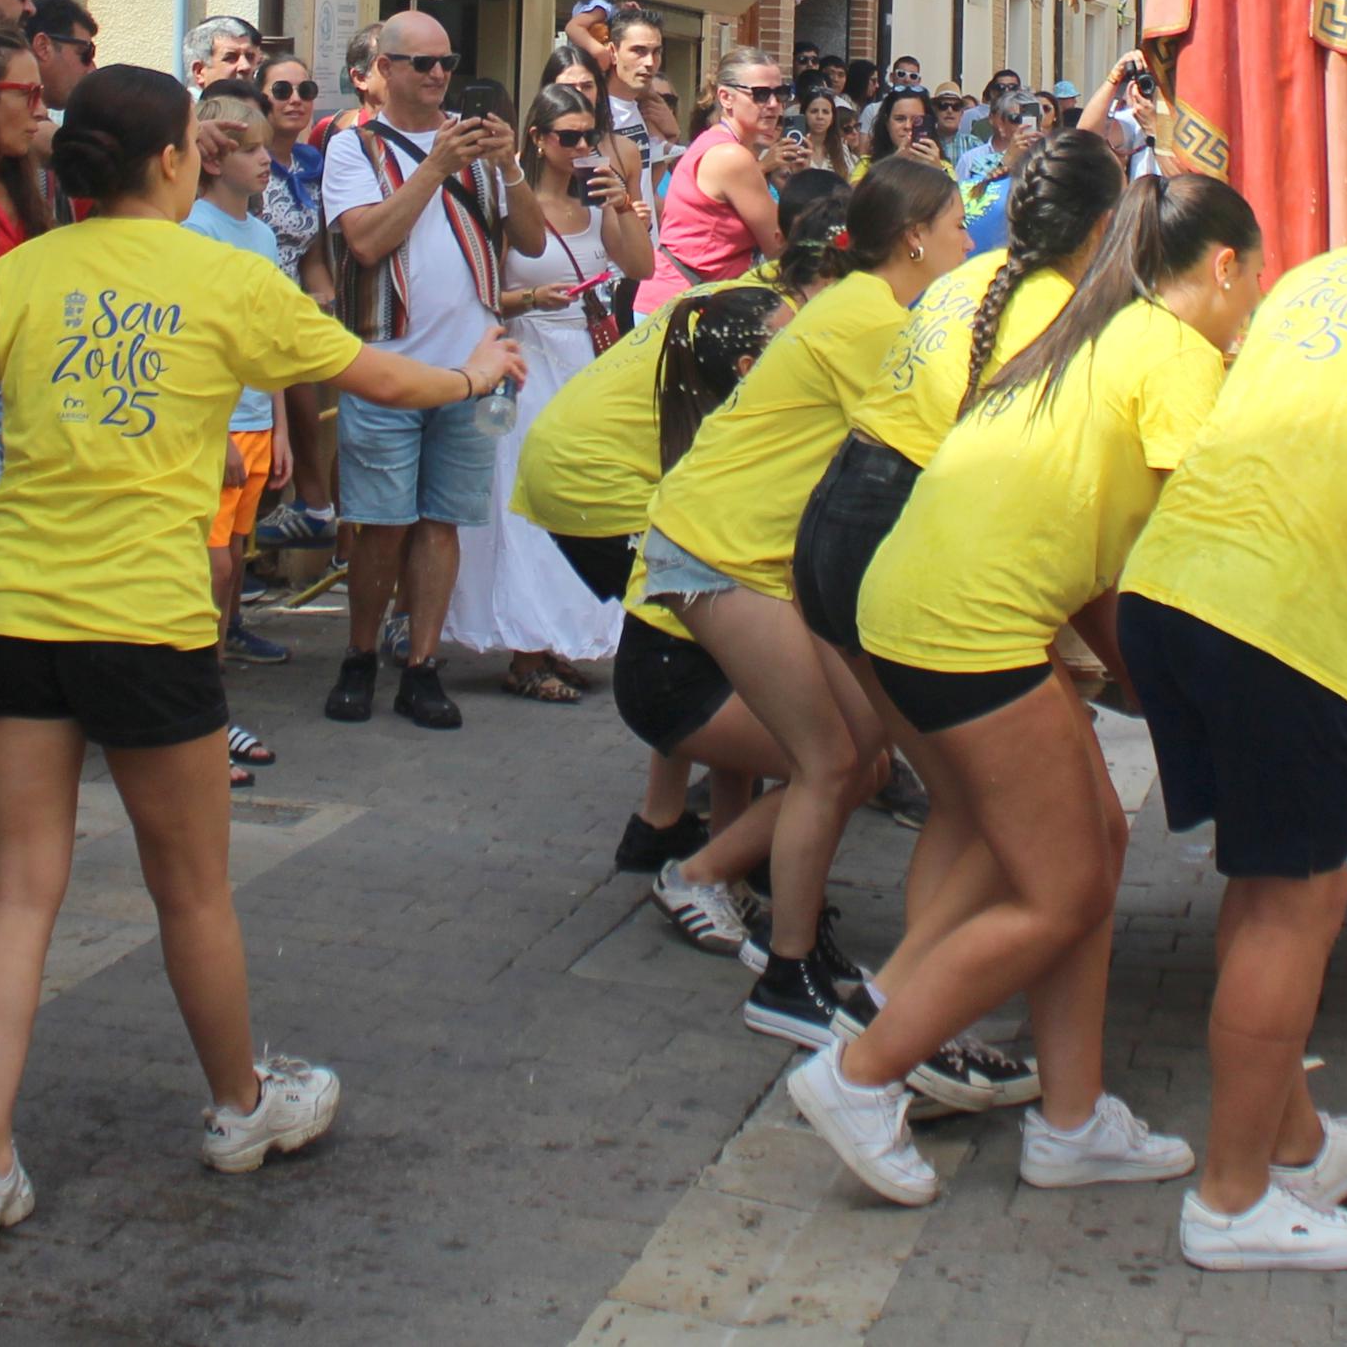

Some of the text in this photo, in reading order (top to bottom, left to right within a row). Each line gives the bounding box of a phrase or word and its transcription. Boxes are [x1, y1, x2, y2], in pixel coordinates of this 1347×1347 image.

[92, 289, 187, 338] San
[51, 333, 170, 388] Zoilo
[99, 385, 160, 438] 25
